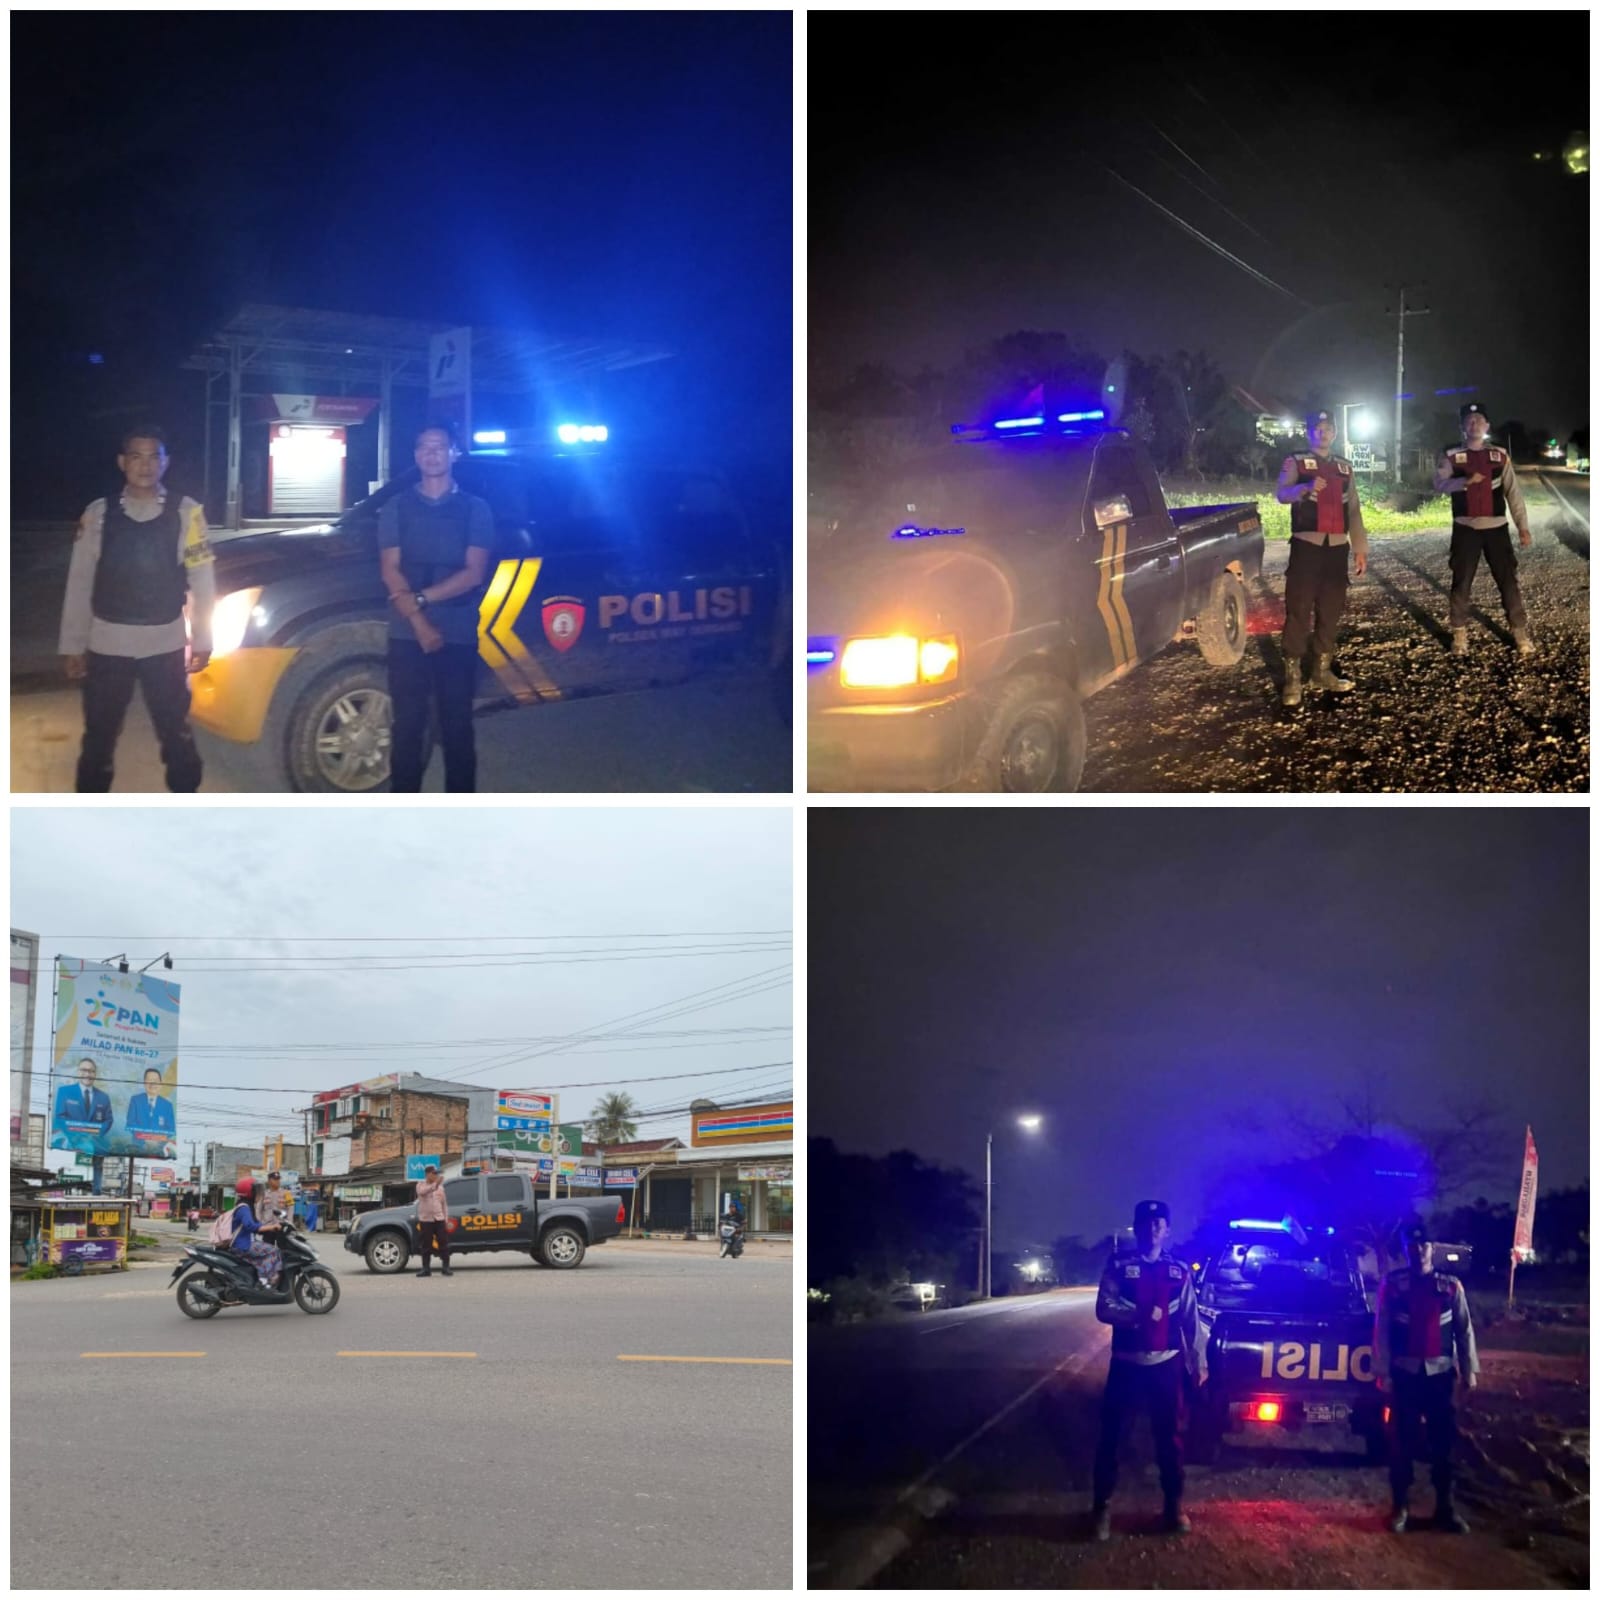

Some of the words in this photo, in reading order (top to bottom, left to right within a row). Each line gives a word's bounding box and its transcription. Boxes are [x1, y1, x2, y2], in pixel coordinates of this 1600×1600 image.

[598, 587, 752, 628] POLISI
[116, 1007, 159, 1029] PAN
[80, 1037, 112, 1050] MILAD
[114, 1042, 133, 1054] PAN
[460, 1213, 522, 1227] POLISI
